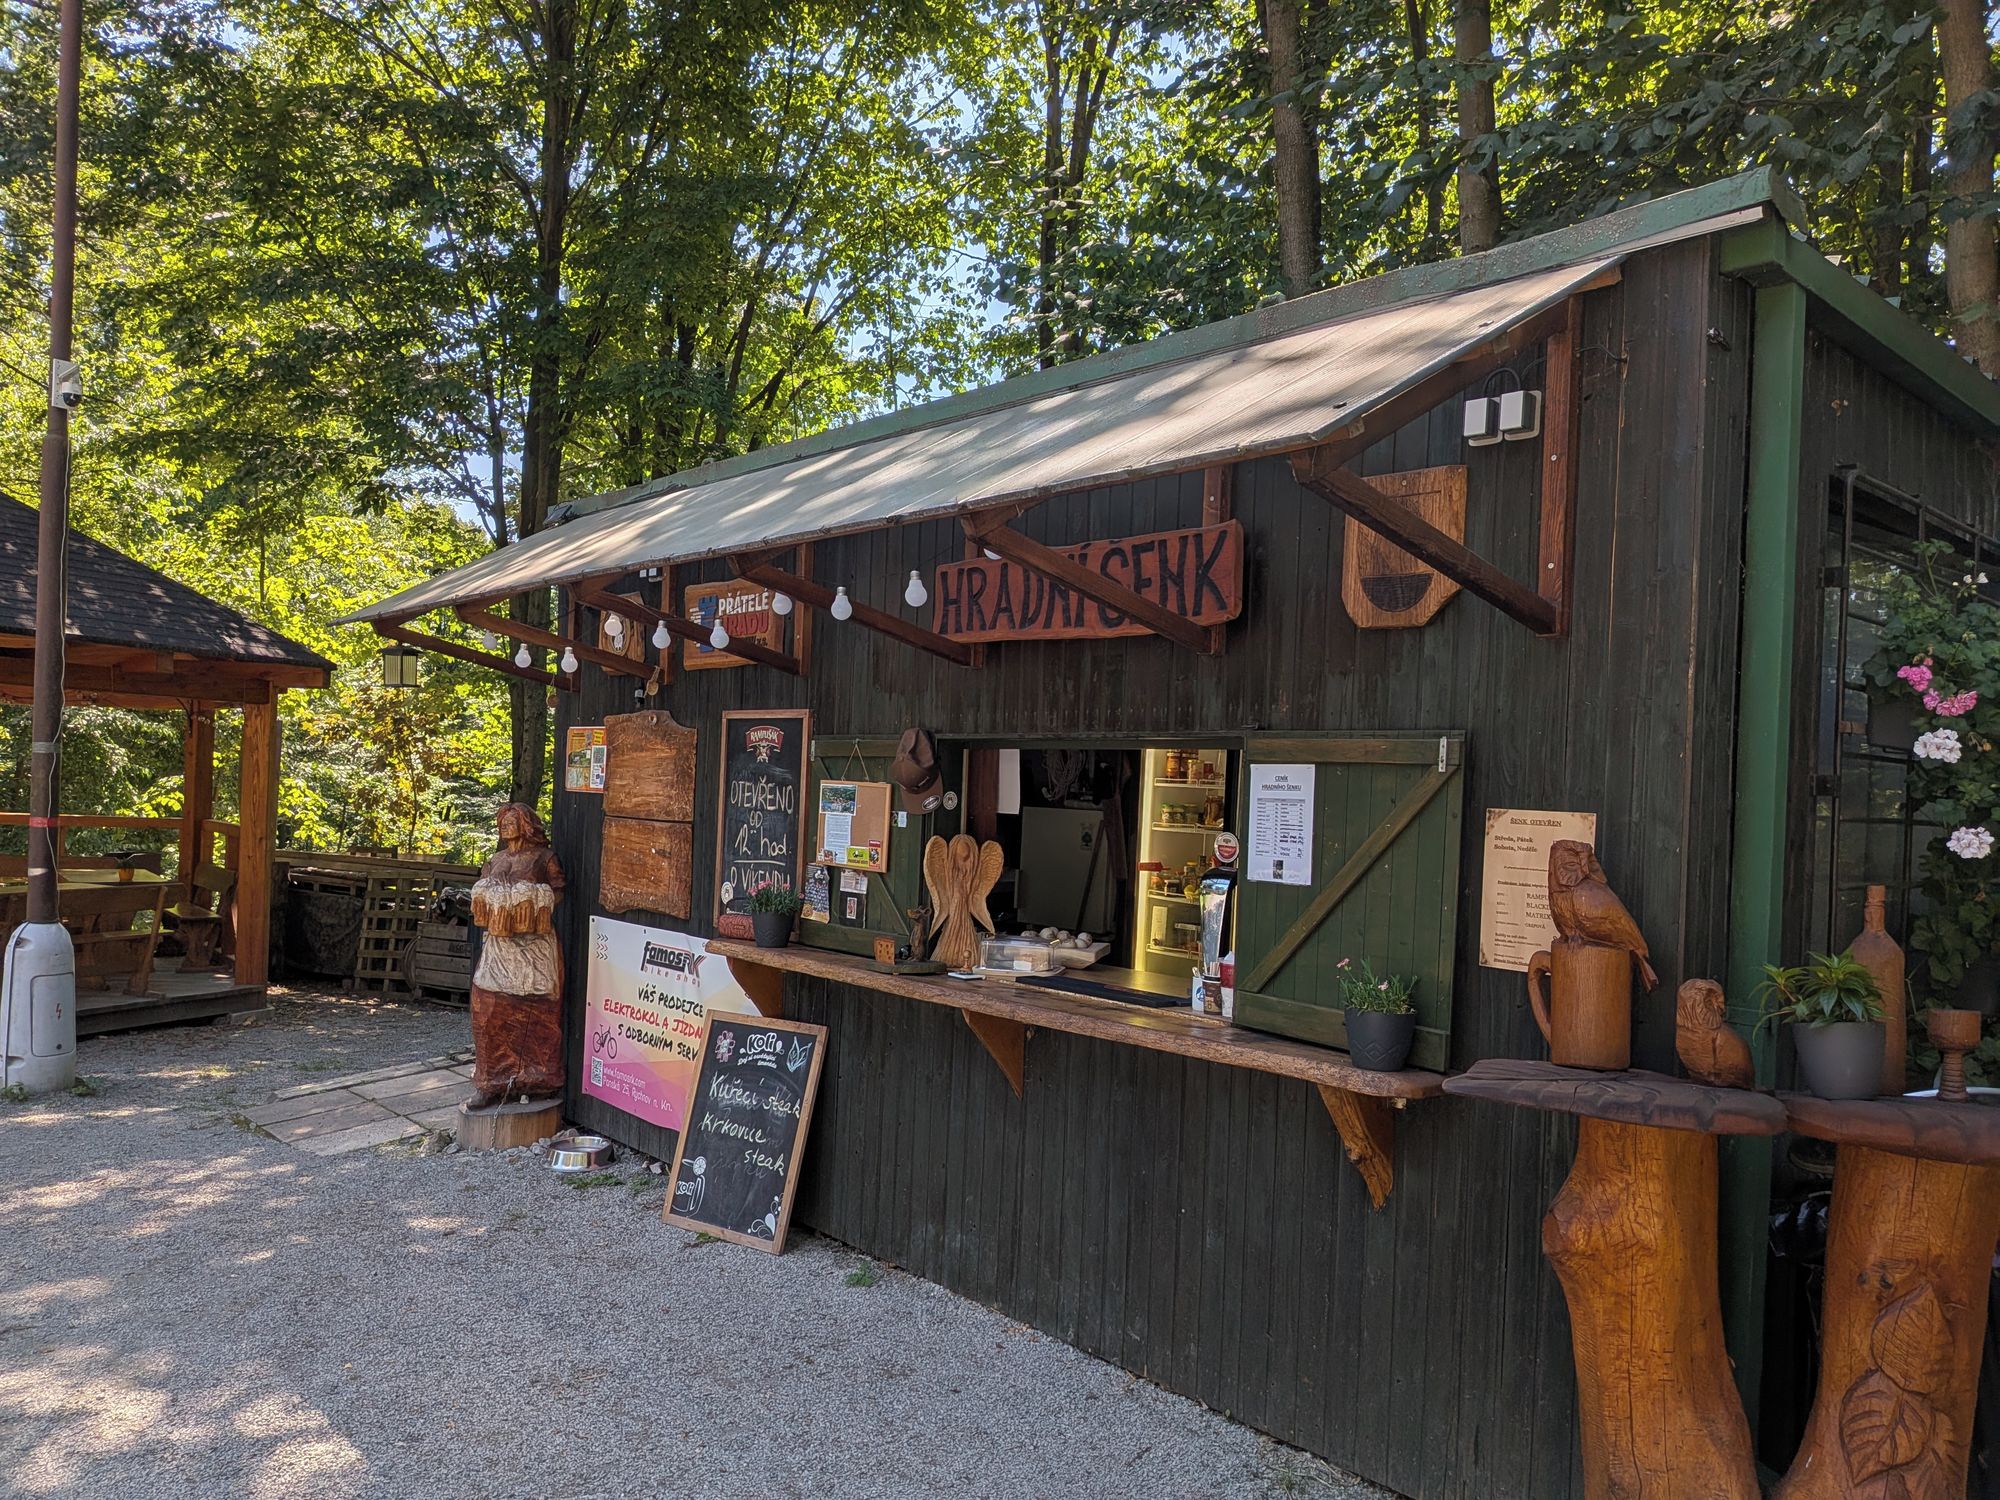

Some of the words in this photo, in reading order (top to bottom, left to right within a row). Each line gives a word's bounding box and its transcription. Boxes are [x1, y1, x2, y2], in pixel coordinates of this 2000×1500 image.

[718, 588, 769, 616] PŘÁTELÉ
[730, 775, 794, 815] OTEVŘENO
[749, 810, 763, 829] OD
[1510, 817, 1528, 825] ŠENK
[1529, 819, 1562, 828] OTEVŘEN
[760, 825, 792, 857] hod.
[1493, 844, 1516, 852] Sobota,
[1494, 835, 1516, 843] Středa,
[1516, 836, 1534, 844] Pátek
[1526, 893, 1550, 901] RAMPU
[1525, 911, 1552, 921] MATRIX
[643, 964, 670, 979] bike
[638, 983, 657, 1004] VÁŠ
[658, 991, 704, 1019] PRODEJCE
[603, 998, 660, 1027] ELEKTROKOL
[661, 1015, 670, 1031] A
[671, 1013, 704, 1041] JÍZDN
[617, 1023, 624, 1037] S
[625, 1025, 673, 1053] ODBORNÝM
[677, 1042, 700, 1063] SERV
[762, 1091, 801, 1119] steak
[743, 1147, 785, 1177] steak
